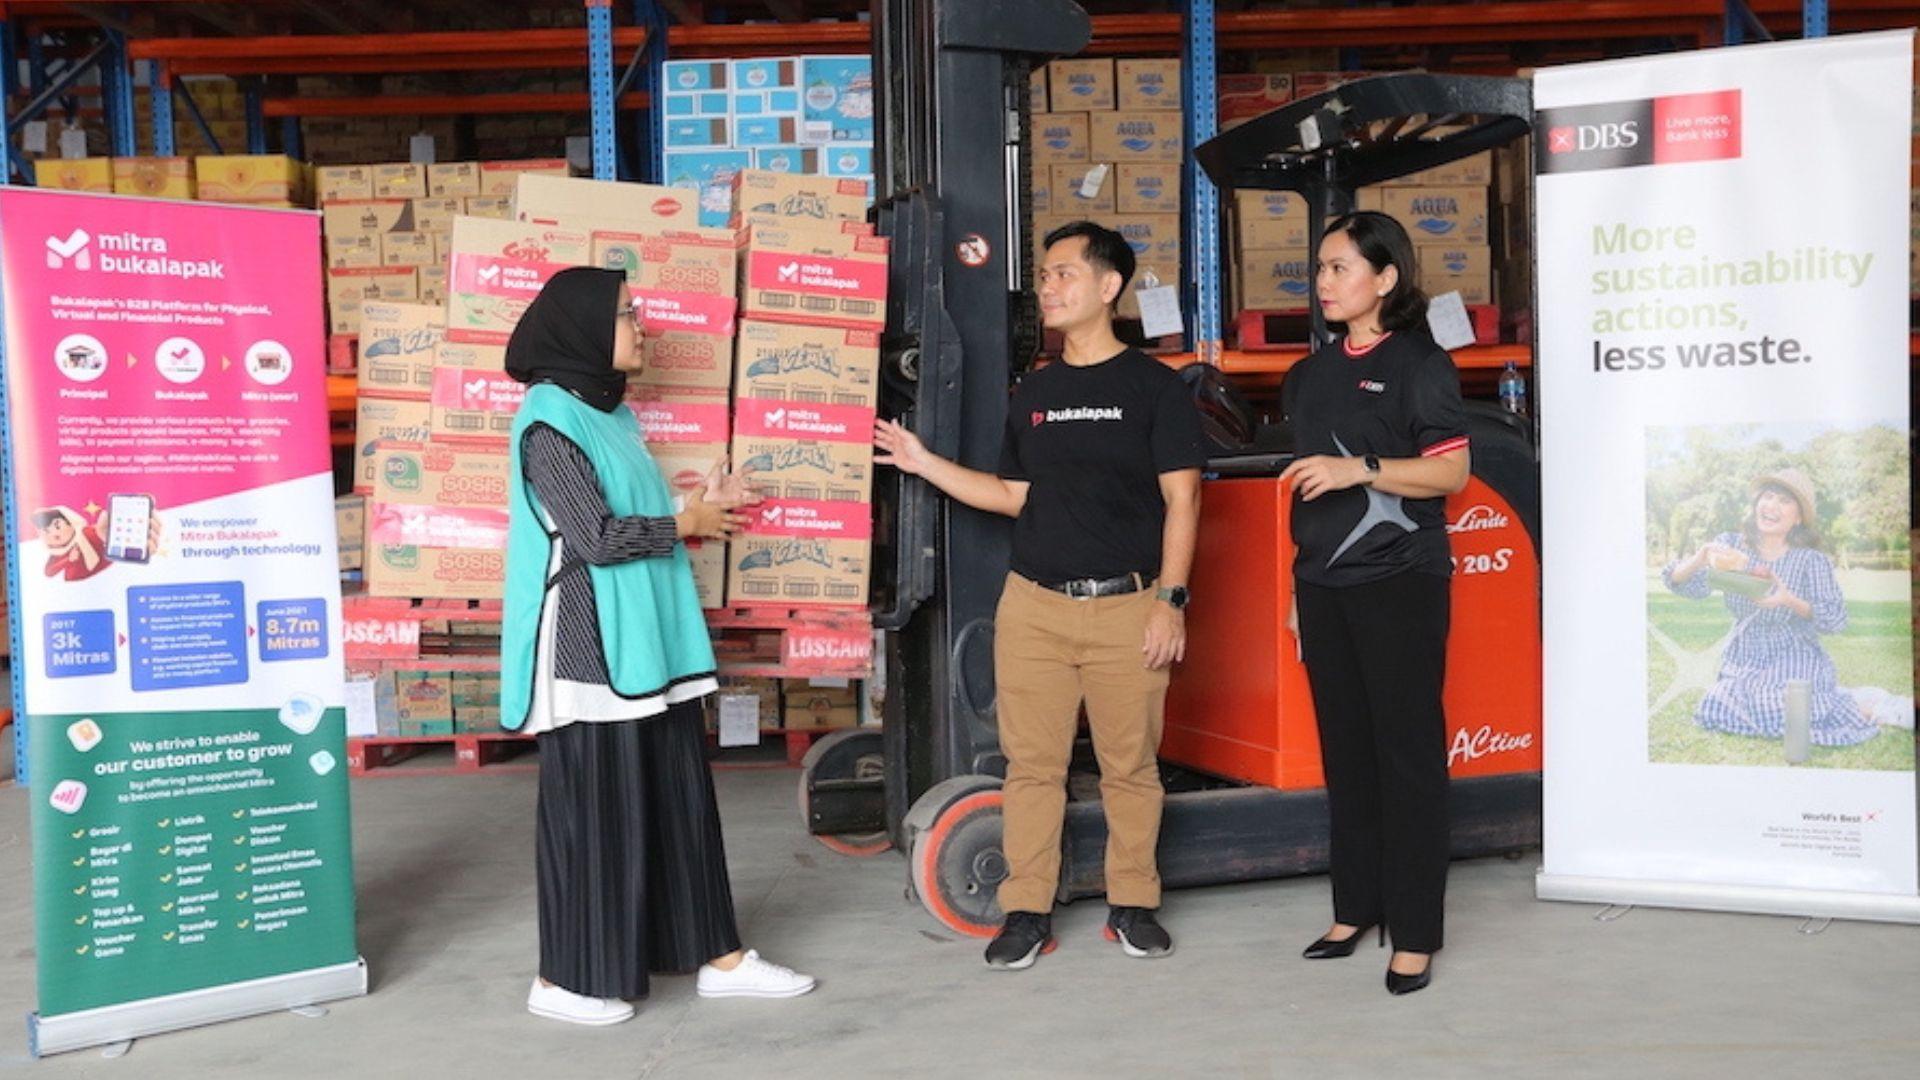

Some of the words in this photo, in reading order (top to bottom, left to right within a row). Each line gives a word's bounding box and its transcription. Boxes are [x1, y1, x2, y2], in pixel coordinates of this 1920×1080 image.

[1116, 122, 1155, 136] AQUA
[1666, 117, 1692, 128] Live
[1578, 120, 1638, 151] DBS
[1666, 130, 1697, 142] Bank
[1702, 129, 1728, 140] less
[1410, 198, 1459, 215] AQUA
[98, 232, 167, 254] mitra
[1592, 222, 1696, 255] More
[100, 254, 225, 279] bukalapak
[502, 267, 538, 279] mitra
[801, 264, 834, 275] mitra
[1272, 261, 1310, 279] AQU
[1592, 246, 1874, 296] sustainability
[659, 267, 719, 284] SOSIS
[801, 275, 860, 290] bukalapak
[51, 295, 125, 310] Bukalapak's
[151, 299, 202, 312] Platform
[204, 302, 221, 312] for
[645, 299, 680, 310] mitra
[52, 309, 95, 320] Virtual
[97, 311, 119, 321] and
[120, 311, 173, 323] Financial
[175, 313, 224, 325] Products
[645, 309, 708, 324] bukalapak
[1592, 298, 1748, 334] actions,
[655, 341, 714, 358] SOSIS
[1593, 339, 1667, 373] less
[1676, 335, 1812, 368] waste.
[488, 380, 525, 392] mitra
[787, 409, 820, 420] mitra
[1046, 406, 1123, 422] bukalapak
[787, 420, 847, 434] bukalapak
[442, 476, 506, 494] SOSIS
[785, 507, 817, 518] mitra
[1445, 504, 1509, 534] Linde
[180, 517, 202, 528] We
[203, 517, 258, 530] empower
[785, 518, 845, 531] bukalapak
[181, 530, 215, 542] Mitra
[217, 528, 279, 542] Bukalapak
[182, 545, 240, 558] through
[242, 543, 321, 557] technology
[439, 553, 504, 571] SOSIS
[266, 618, 320, 634] 8.7m
[52, 632, 82, 649] 3k
[266, 637, 320, 650] Mitras
[53, 652, 110, 666] Mitras
[130, 741, 153, 753] We
[155, 738, 197, 752] strive
[199, 736, 213, 748] to
[214, 730, 260, 745] enable
[95, 760, 129, 775] our
[132, 752, 223, 772] customer
[226, 748, 245, 762] to
[248, 744, 293, 763] grow
